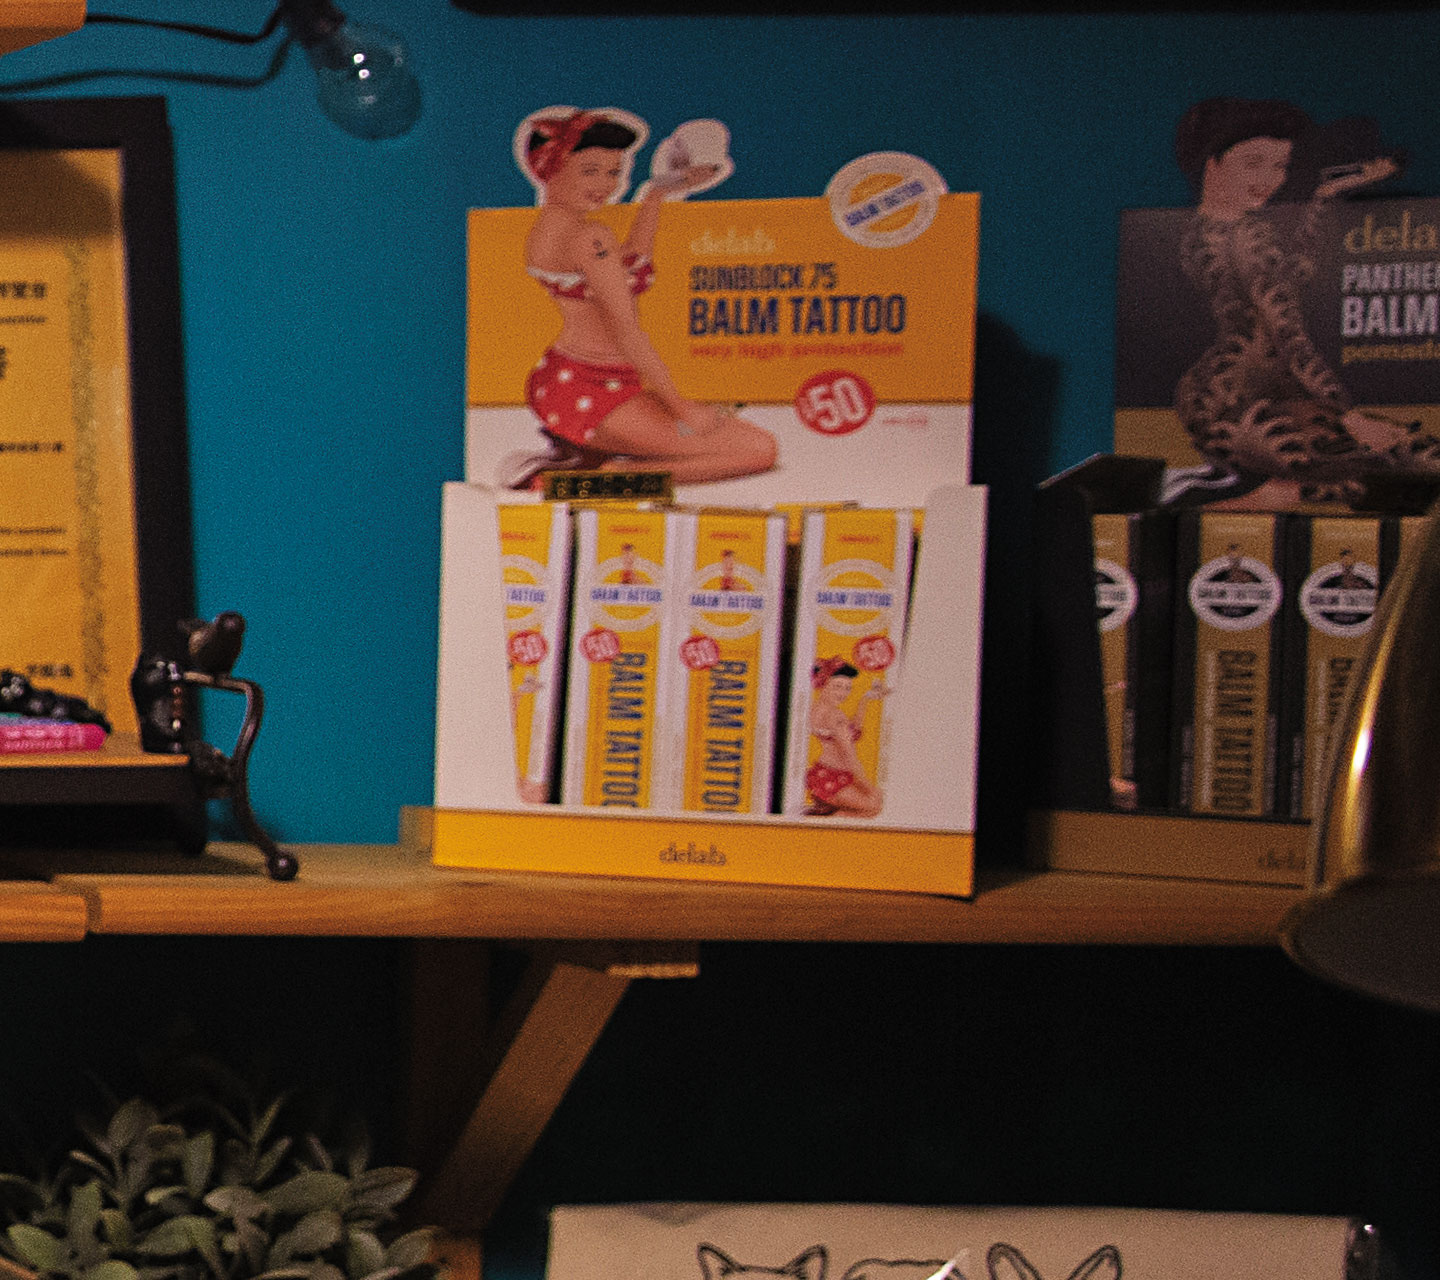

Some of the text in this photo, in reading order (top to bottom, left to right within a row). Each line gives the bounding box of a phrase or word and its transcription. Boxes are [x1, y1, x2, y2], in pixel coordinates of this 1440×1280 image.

[1342, 209, 1440, 254] dela
[688, 294, 907, 337] BALM TATTOO
[1341, 294, 1440, 338] BALM
[806, 377, 868, 430] 50
[605, 651, 649, 722] BALM
[702, 659, 749, 813] BALM TATTO
